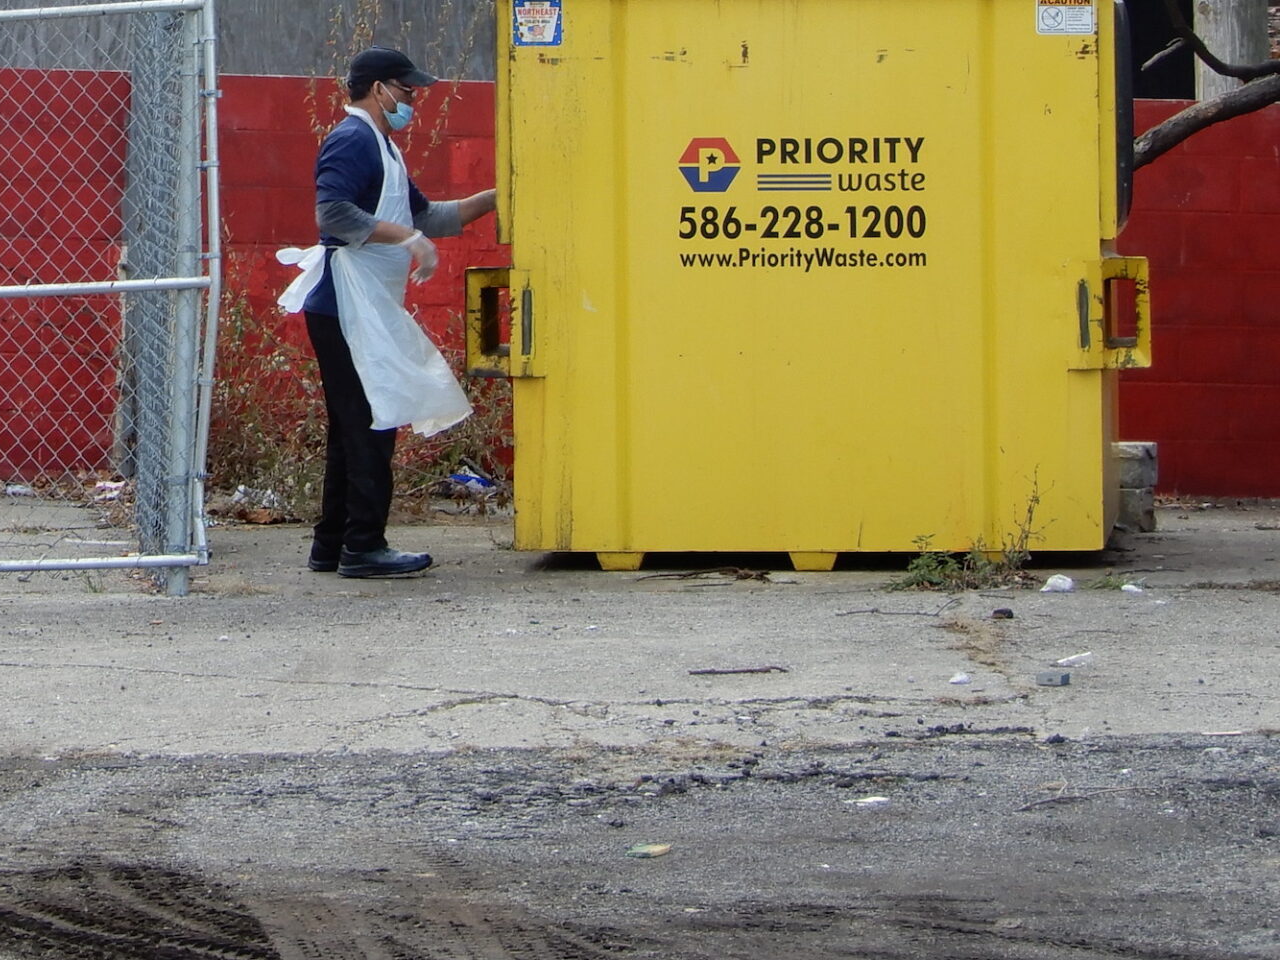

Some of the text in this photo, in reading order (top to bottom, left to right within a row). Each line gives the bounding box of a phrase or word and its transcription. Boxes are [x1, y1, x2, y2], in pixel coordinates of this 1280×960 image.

[517, 8, 557, 16] NORTHEAST
[756, 136, 925, 164] PRIORITY
[838, 168, 926, 191] waste
[678, 205, 926, 239] 586-228-1200
[680, 247, 927, 272] www.PriorityWaste.com
